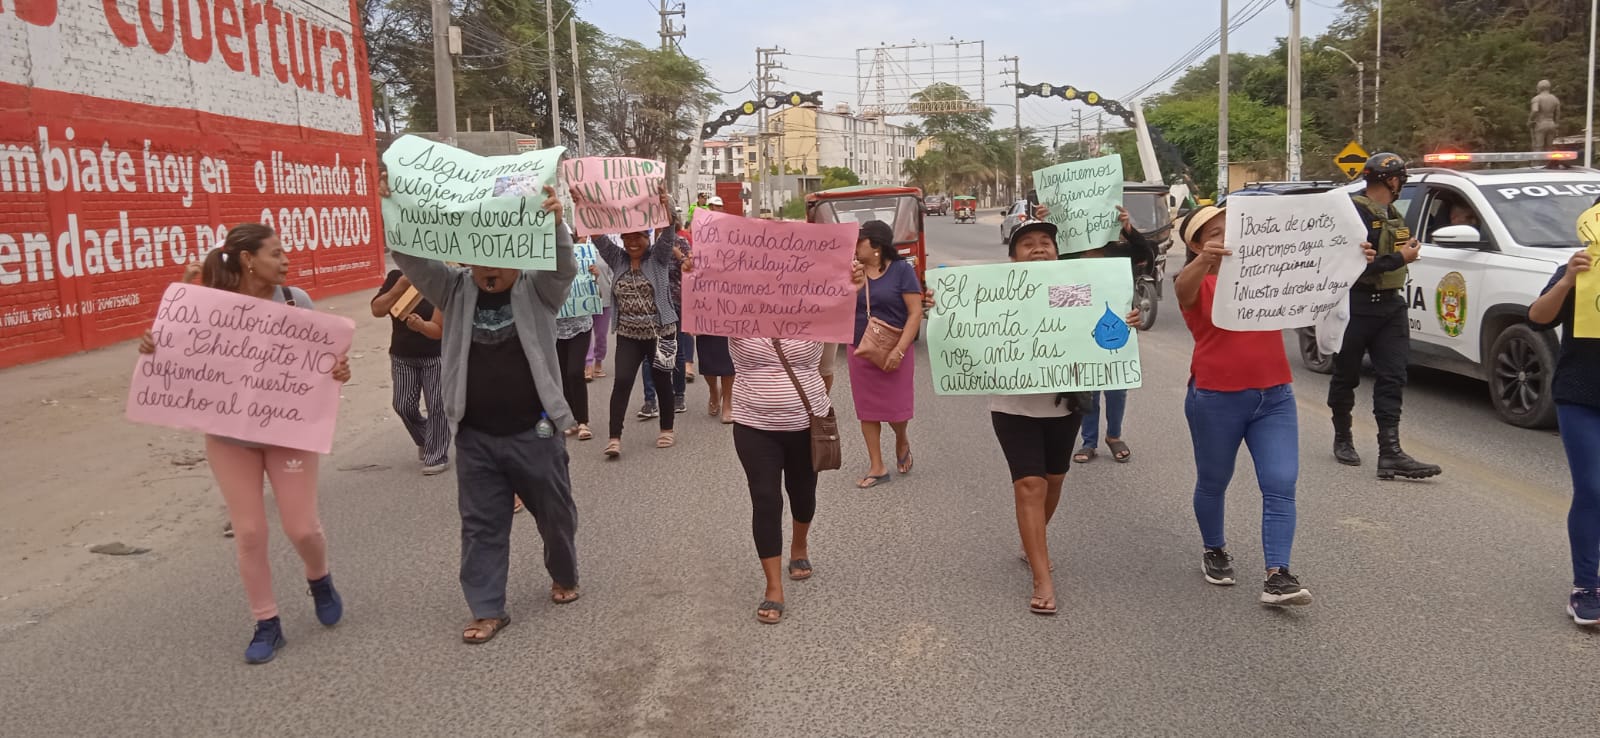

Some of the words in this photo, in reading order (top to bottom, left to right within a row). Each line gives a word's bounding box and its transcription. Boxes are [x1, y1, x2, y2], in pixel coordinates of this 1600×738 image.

[143, 139, 194, 208] hoy
[199, 156, 231, 193] en
[254, 160, 267, 193] o
[271, 150, 350, 196] llamando
[354, 158, 368, 196] al
[398, 145, 544, 184] Seguiremos
[564, 160, 584, 184] NO
[600, 159, 664, 179] TENEMOS
[390, 176, 492, 207] exigiendo
[1497, 183, 1600, 200] POLIC
[399, 201, 465, 227] nuestro
[471, 196, 548, 228] derecho
[1285, 215, 1297, 231] de
[387, 223, 407, 247] al
[411, 227, 462, 256] AGUA
[468, 233, 555, 260] POTABLE
[695, 214, 721, 243] Los
[727, 228, 841, 251] ciudadanos
[692, 252, 711, 270] de
[716, 249, 815, 281] Chiclayito
[1238, 244, 1297, 264] queremos
[1298, 240, 1324, 259] agua
[1329, 234, 1349, 247] sin
[779, 277, 849, 297] medidas
[935, 273, 970, 316] El
[975, 269, 1043, 317] pueblo
[1316, 276, 1329, 293] al
[1328, 281, 1349, 296] agua
[158, 287, 201, 325] Las
[208, 304, 335, 346] autoridades
[692, 297, 711, 312] si
[717, 299, 737, 316] NO
[740, 302, 755, 314] se
[760, 299, 825, 316] escucha
[1238, 305, 1255, 321] no
[1288, 303, 1309, 316] ser
[694, 316, 761, 335] NUESTRA
[772, 320, 812, 336] VOZ
[943, 310, 1029, 341] levanta
[1033, 317, 1067, 338] su
[152, 325, 175, 349] de
[184, 326, 299, 373] Chiclayito
[301, 350, 338, 375] NO
[940, 348, 980, 372] voz
[984, 340, 1025, 365] ante
[1029, 337, 1066, 362] las
[142, 357, 233, 391] defienden
[240, 372, 314, 396] nuestro
[940, 367, 1040, 392] autoridades
[1039, 360, 1141, 388] INCOMPETENTES
[137, 385, 214, 411] derecho
[216, 392, 243, 416] al
